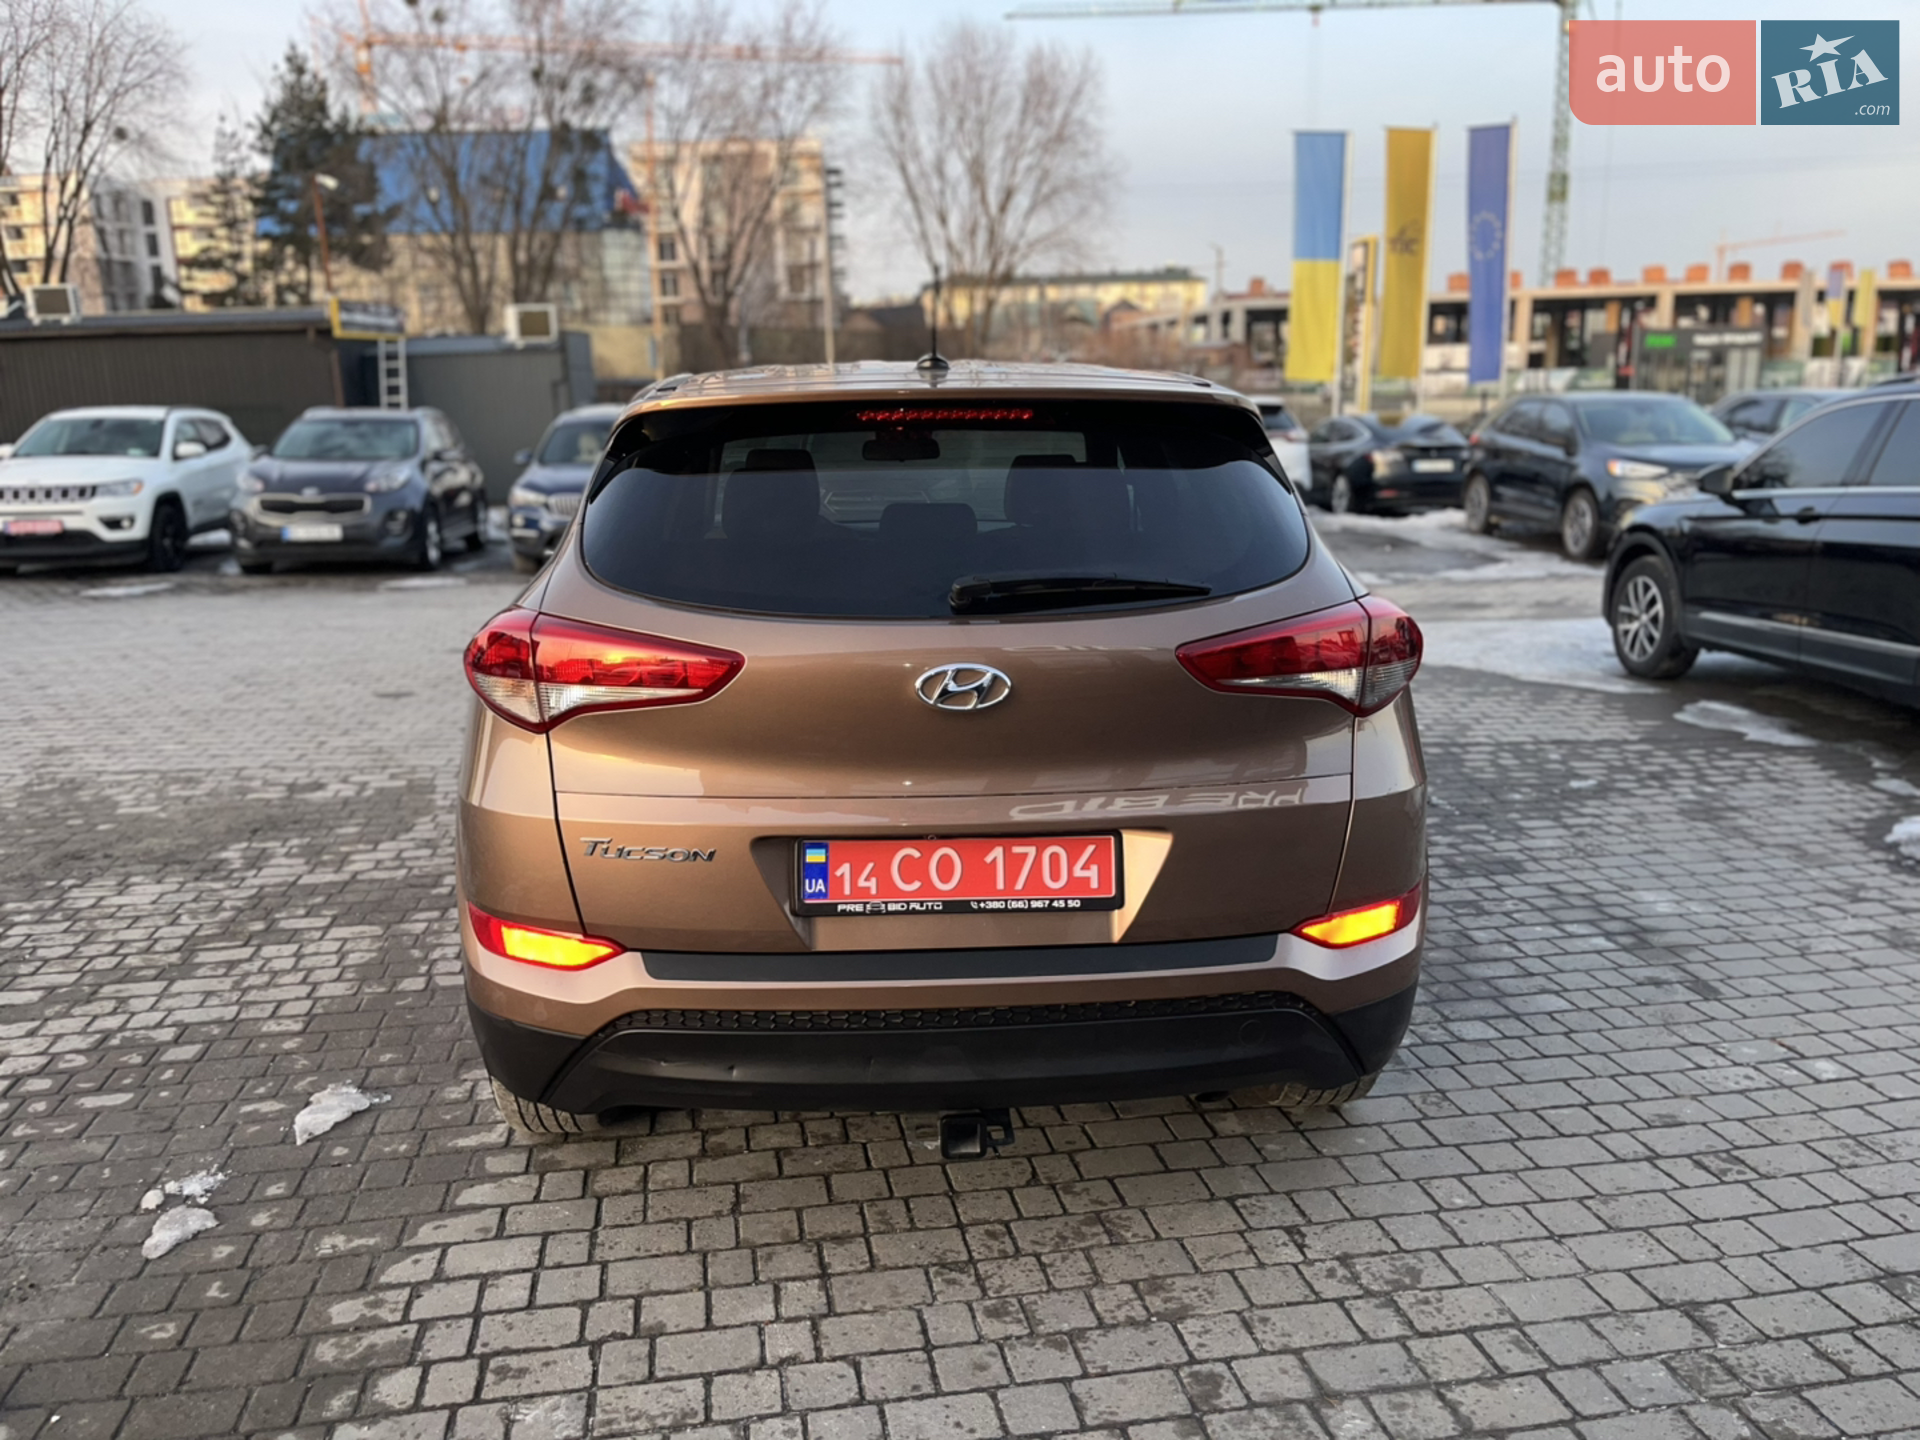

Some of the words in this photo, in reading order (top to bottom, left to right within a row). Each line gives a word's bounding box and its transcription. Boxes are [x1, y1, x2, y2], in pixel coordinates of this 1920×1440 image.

[834, 861, 878, 896] 14
[890, 846, 963, 892] CO
[984, 844, 1100, 891] 1704
[805, 878, 826, 894] UA
[837, 903, 864, 913] PRE
[887, 902, 908, 912] BID
[909, 901, 943, 911] AUTO
[979, 900, 1006, 909] +380
[1051, 899, 1066, 908] 45
[1067, 899, 1081, 908] 50
